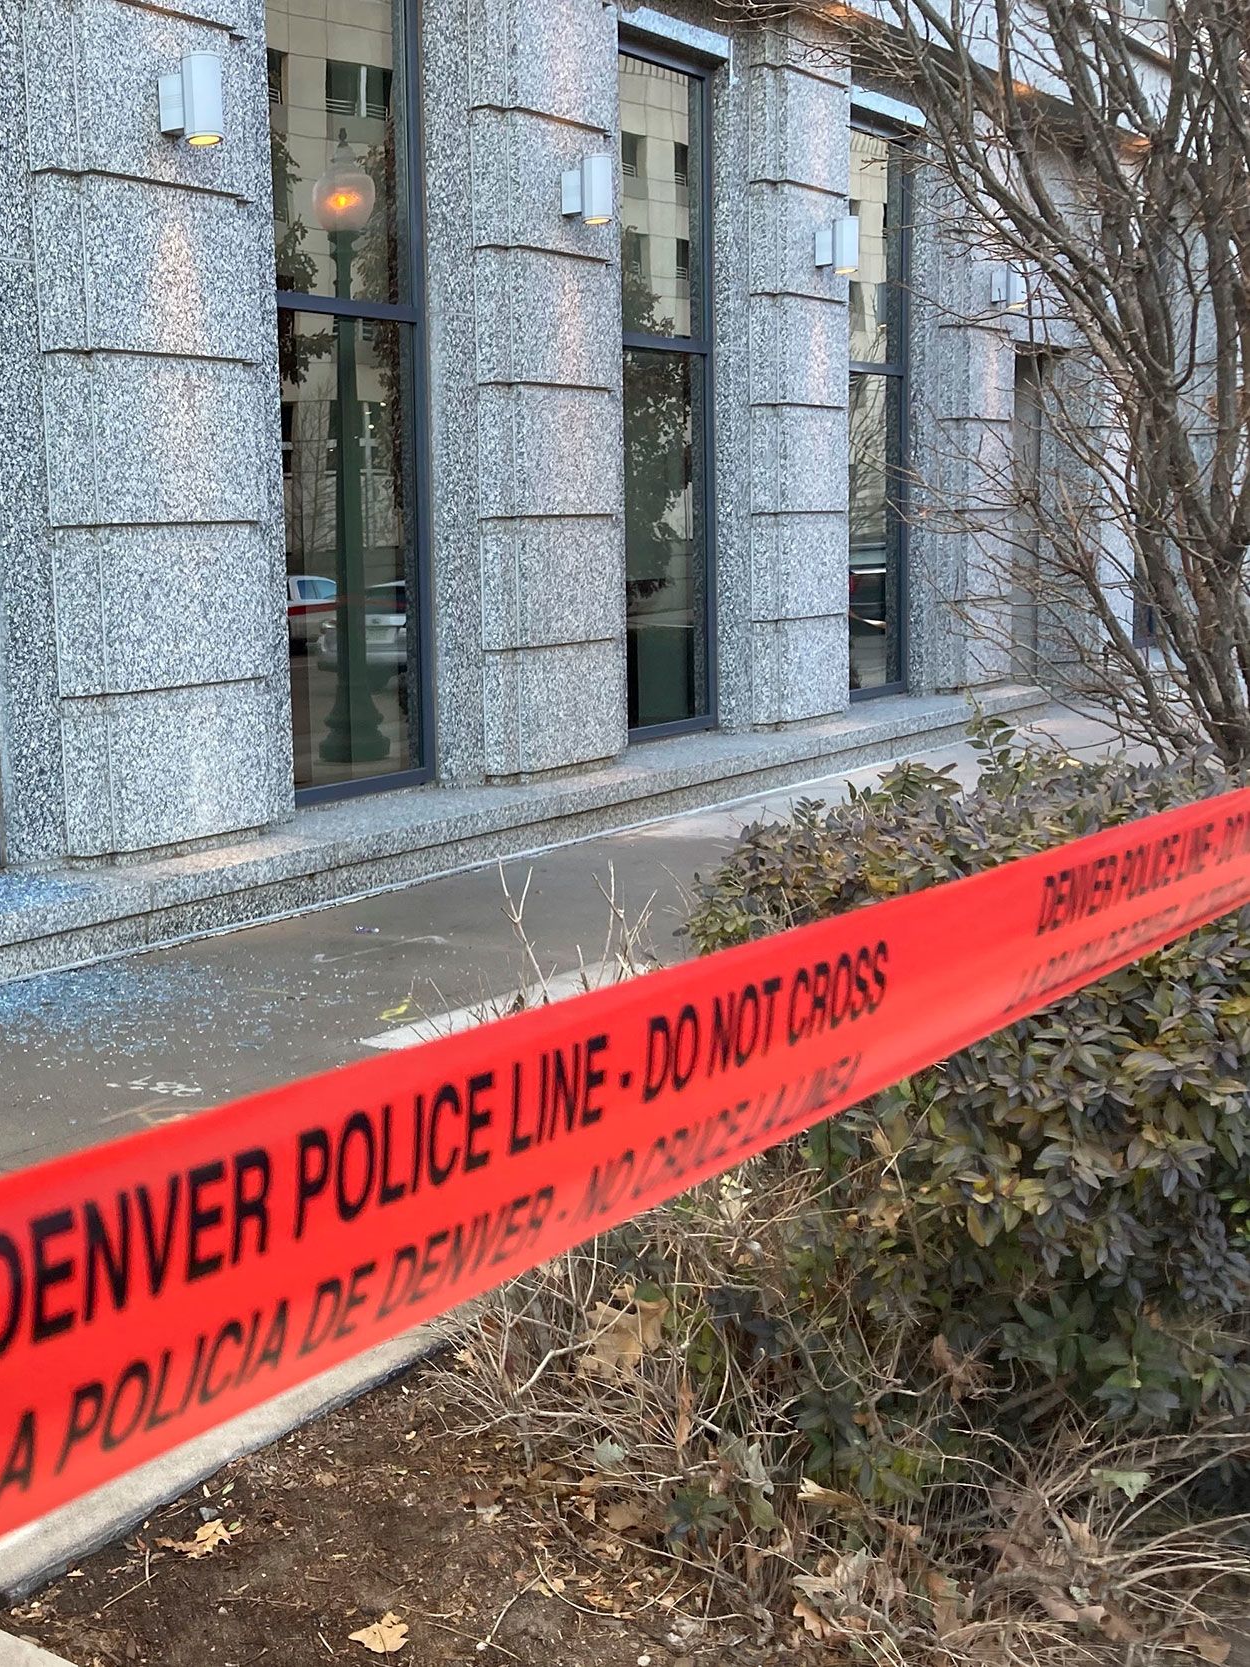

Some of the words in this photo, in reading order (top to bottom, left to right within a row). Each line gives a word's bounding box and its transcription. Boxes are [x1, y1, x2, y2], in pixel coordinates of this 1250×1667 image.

[294, 1070, 493, 1240] POLICE
[509, 1034, 608, 1152] LINE
[642, 1003, 700, 1104] DO
[706, 976, 781, 1079] NOT
[785, 941, 890, 1047] CROSS
[53, 1297, 290, 1476] POLICIA
[296, 1262, 375, 1361] DE
[376, 1184, 555, 1320] DENVER
[568, 1149, 635, 1228] NO
